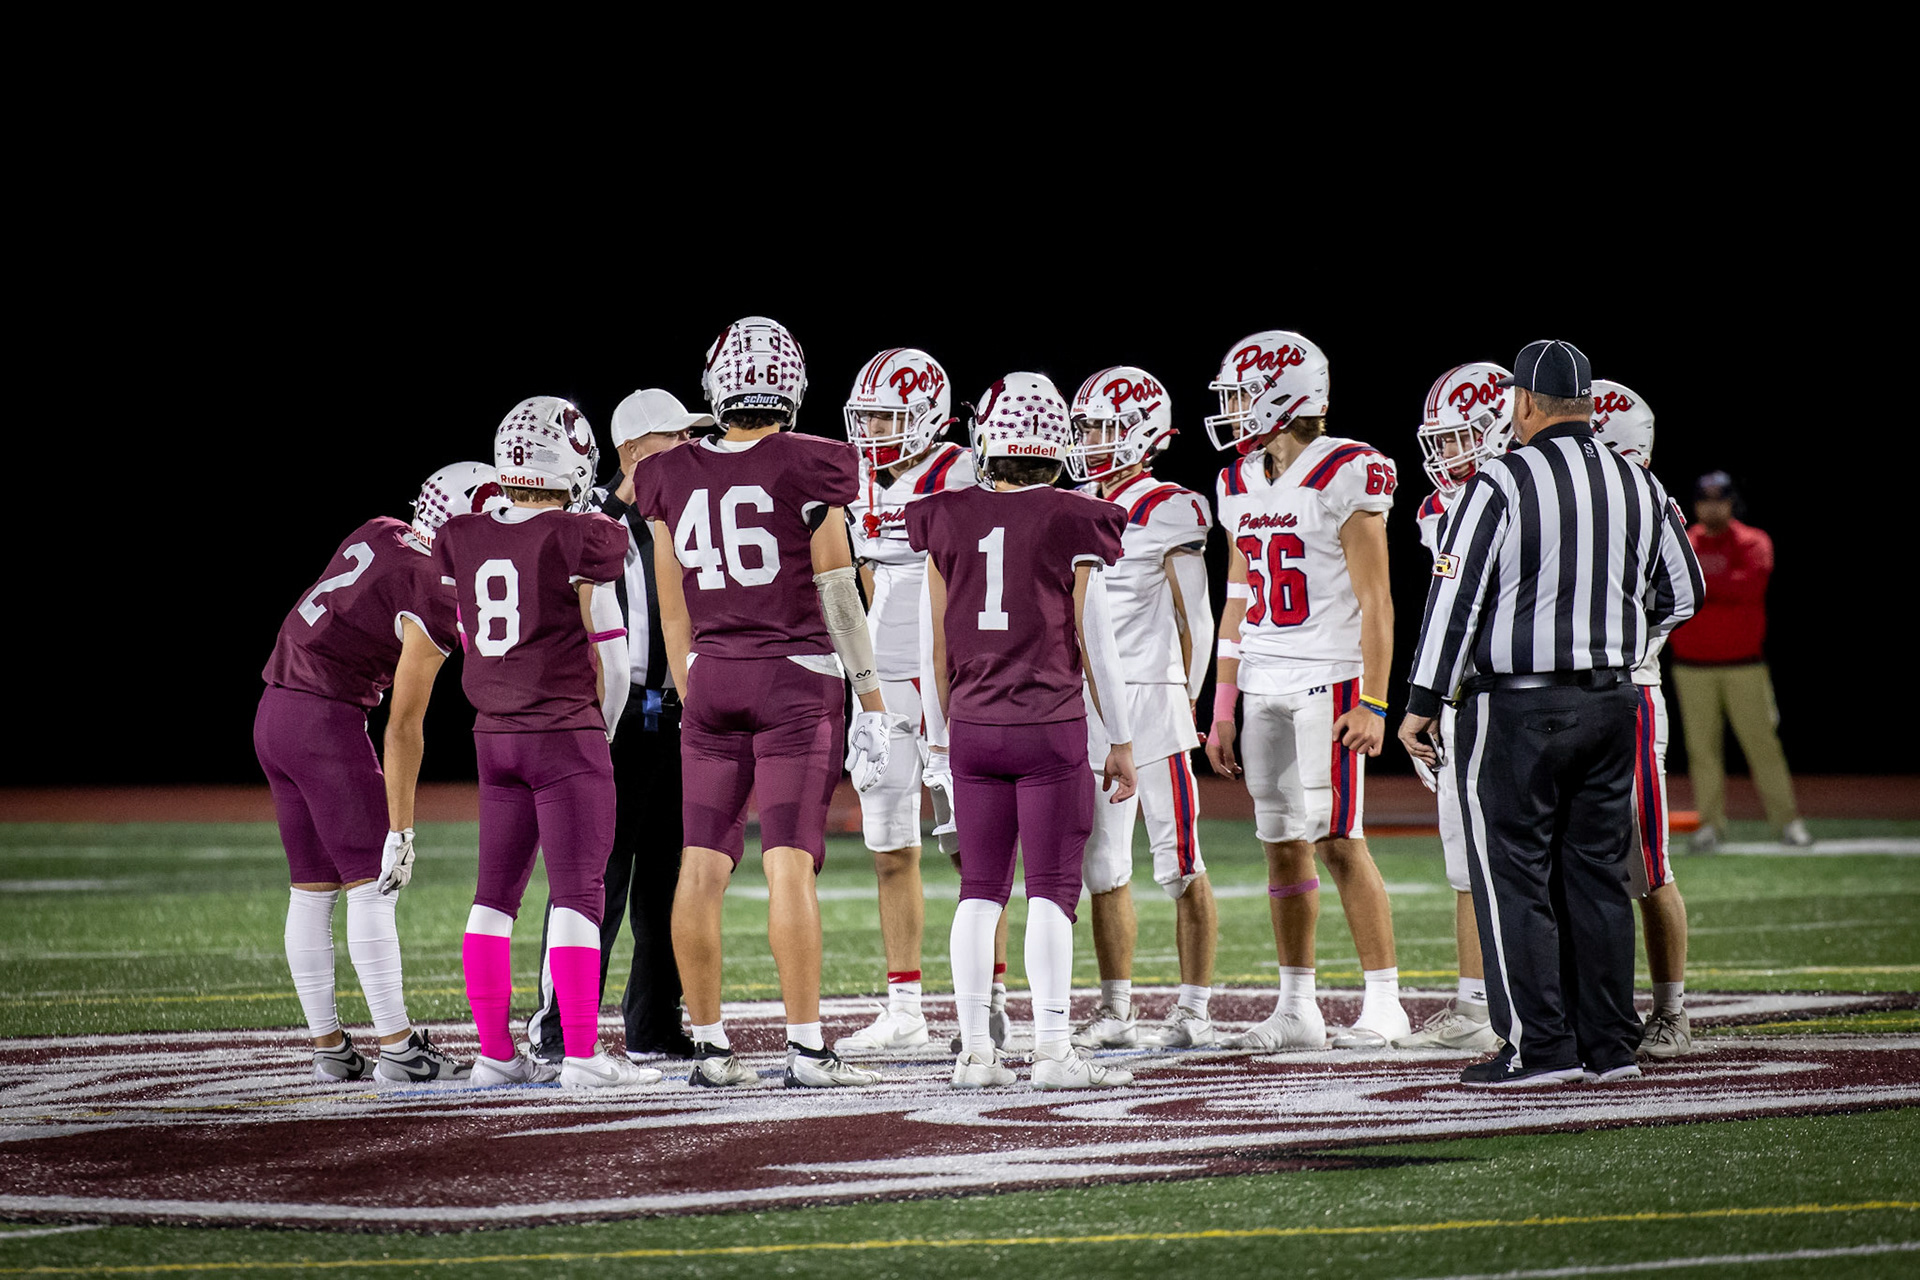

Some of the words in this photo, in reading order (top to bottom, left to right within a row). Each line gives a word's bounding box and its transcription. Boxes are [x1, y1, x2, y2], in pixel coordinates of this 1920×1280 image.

[1233, 345, 1305, 383] Pats
[743, 394, 779, 404] schutt
[1033, 414, 1039, 435] 1
[513, 446, 524, 466] 8
[1007, 444, 1057, 457] Riddell
[500, 475, 544, 487] Riddell
[1365, 462, 1396, 496] 66
[1191, 499, 1207, 526] 1
[674, 485, 781, 590] 46
[297, 541, 375, 627] 2
[978, 527, 1009, 631] 1
[1236, 533, 1310, 627] 66
[475, 559, 520, 657] 8
